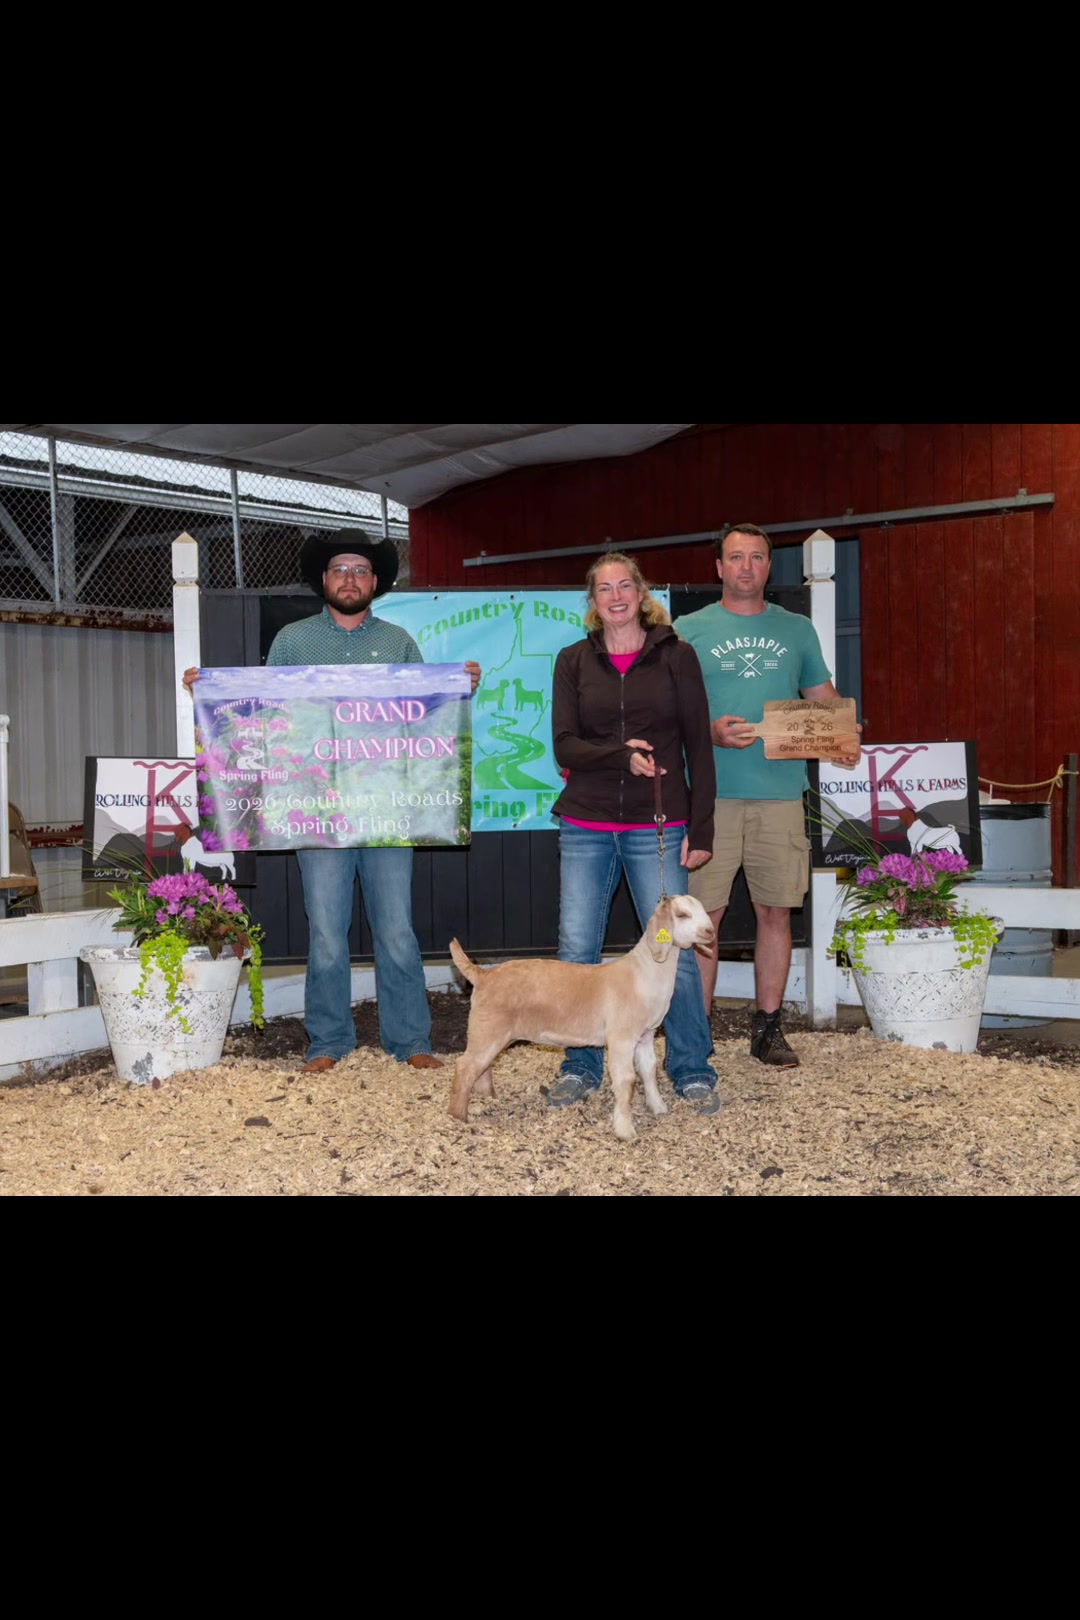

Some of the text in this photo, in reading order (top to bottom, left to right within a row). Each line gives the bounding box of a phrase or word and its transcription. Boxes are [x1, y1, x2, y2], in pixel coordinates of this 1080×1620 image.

[417, 600, 593, 645] Country Roa
[710, 636, 788, 659] PLAASJAPIE
[213, 698, 290, 715] Country Roads
[335, 700, 427, 724] GRAND
[783, 701, 836, 715] Country Roads
[787, 722, 833, 731] 20 26
[791, 735, 835, 744] Spring Fling
[313, 735, 456, 762] CHAMPION
[779, 744, 842, 753] Grand Champion
[219, 770, 289, 782] Spring Fling
[820, 777, 967, 795] ROLLING HILLS K FARMS
[95, 794, 151, 808] ROLLING
[155, 795, 193, 808] HILLS
[225, 790, 463, 813] 2026 Country Roads
[271, 814, 411, 841] Spring Fling
